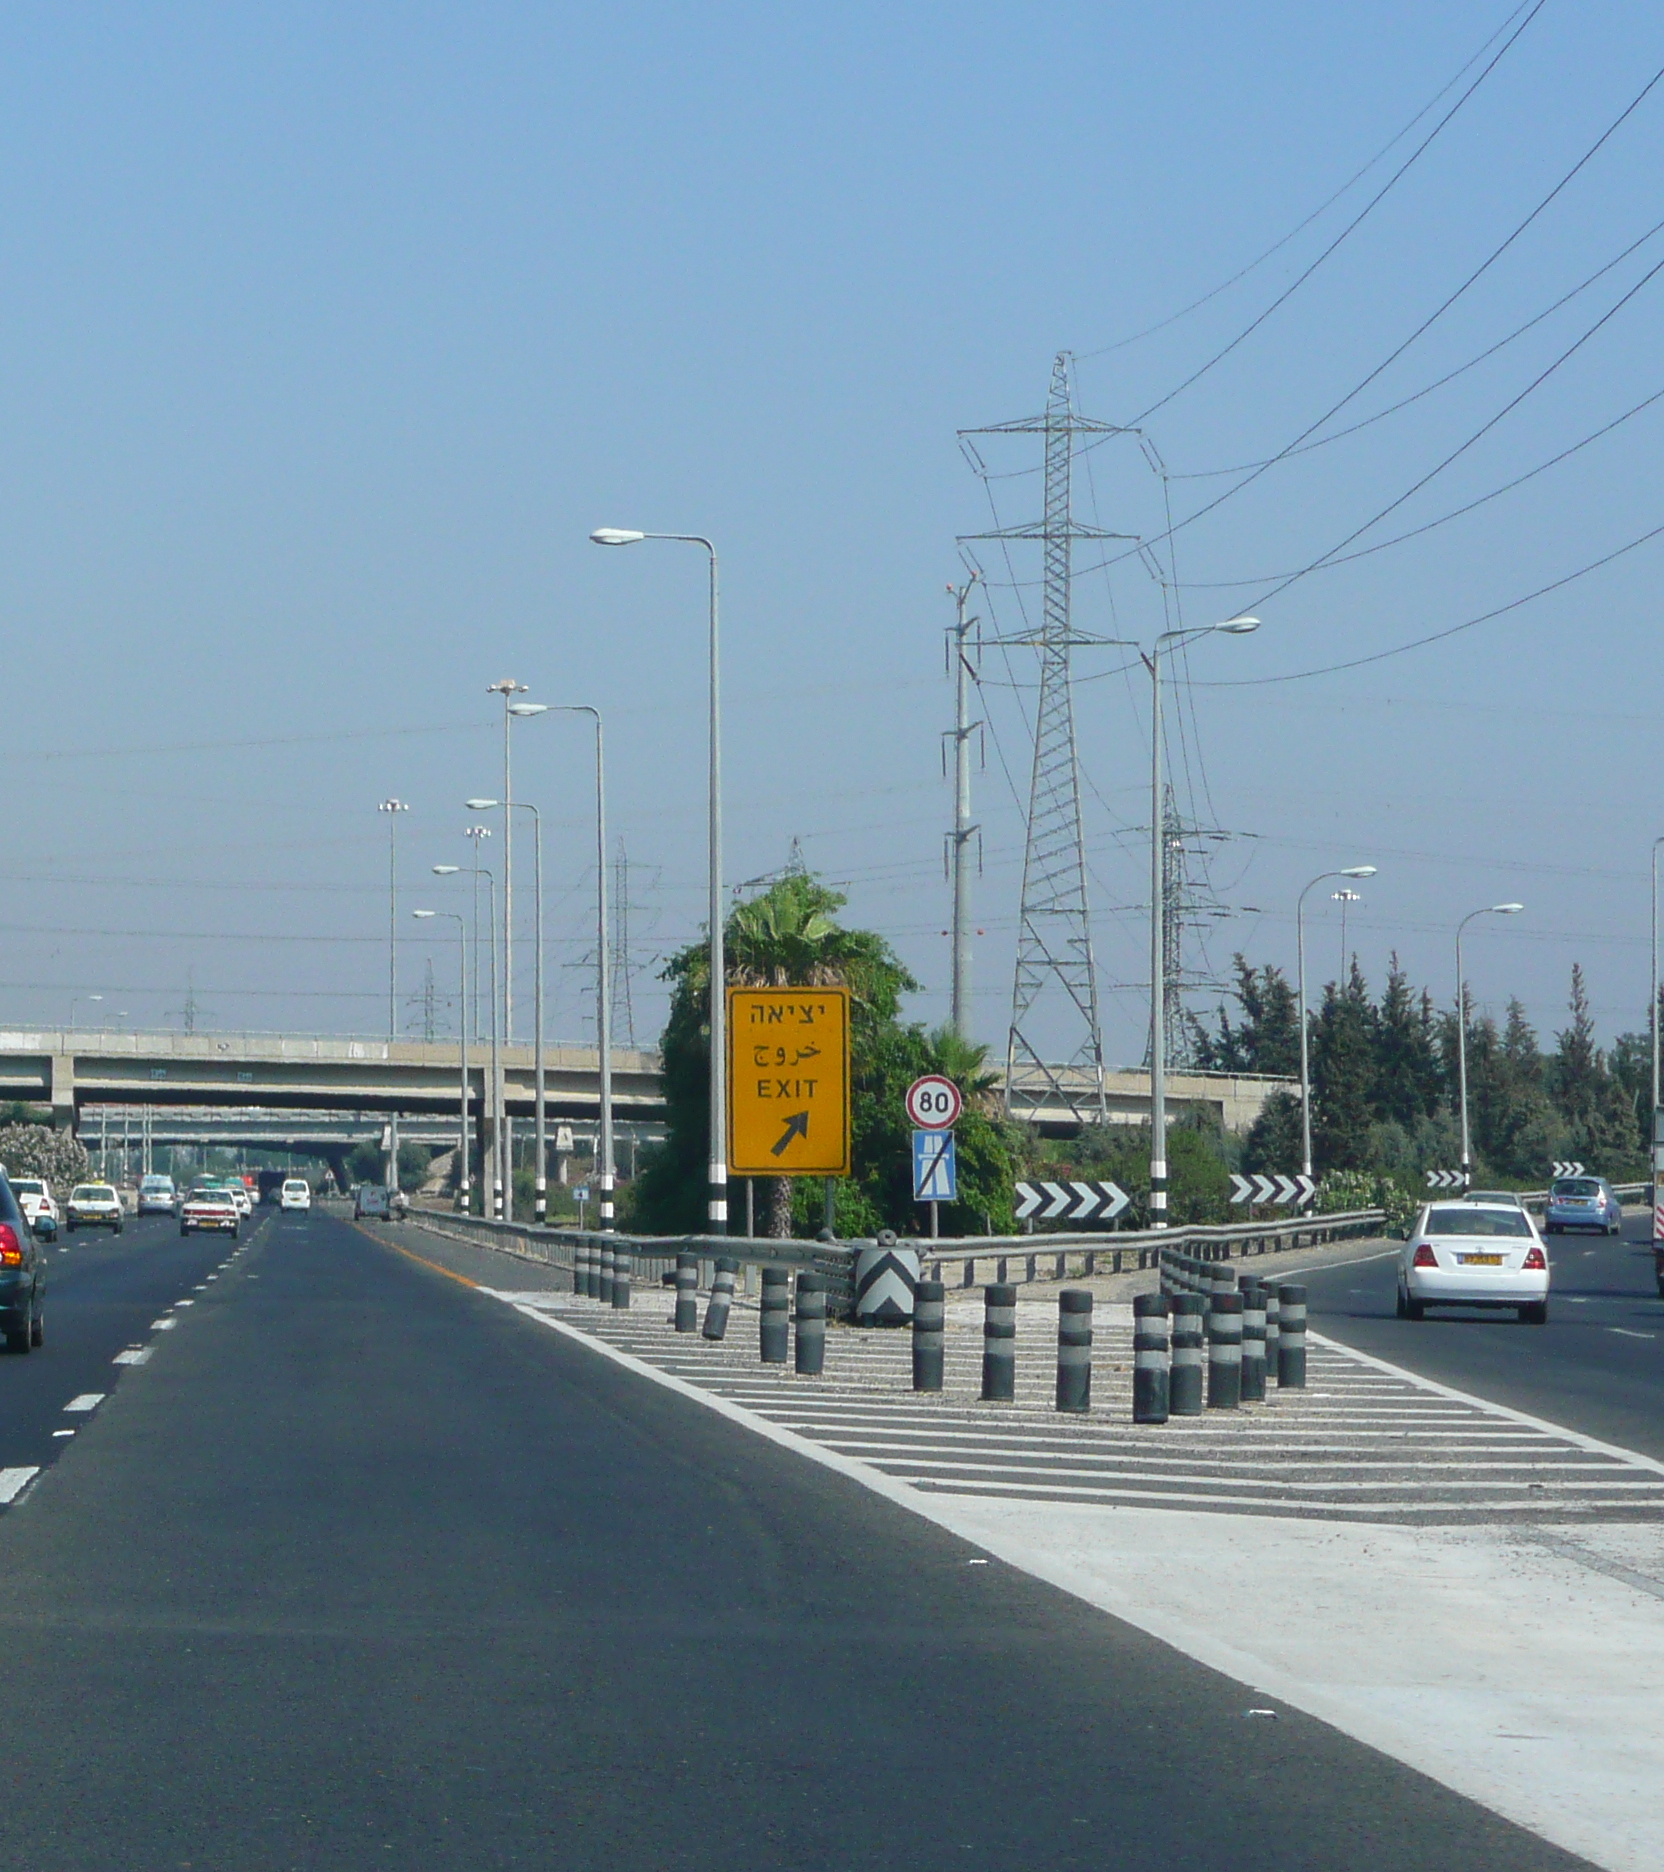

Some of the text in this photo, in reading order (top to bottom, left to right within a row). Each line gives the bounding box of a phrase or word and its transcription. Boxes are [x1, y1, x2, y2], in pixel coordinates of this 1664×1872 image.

[750, 1004, 825, 1024] יציאה
[753, 1041, 821, 1067] خروج
[757, 1079, 818, 1098] EXIT
[919, 1091, 949, 1114] 80
